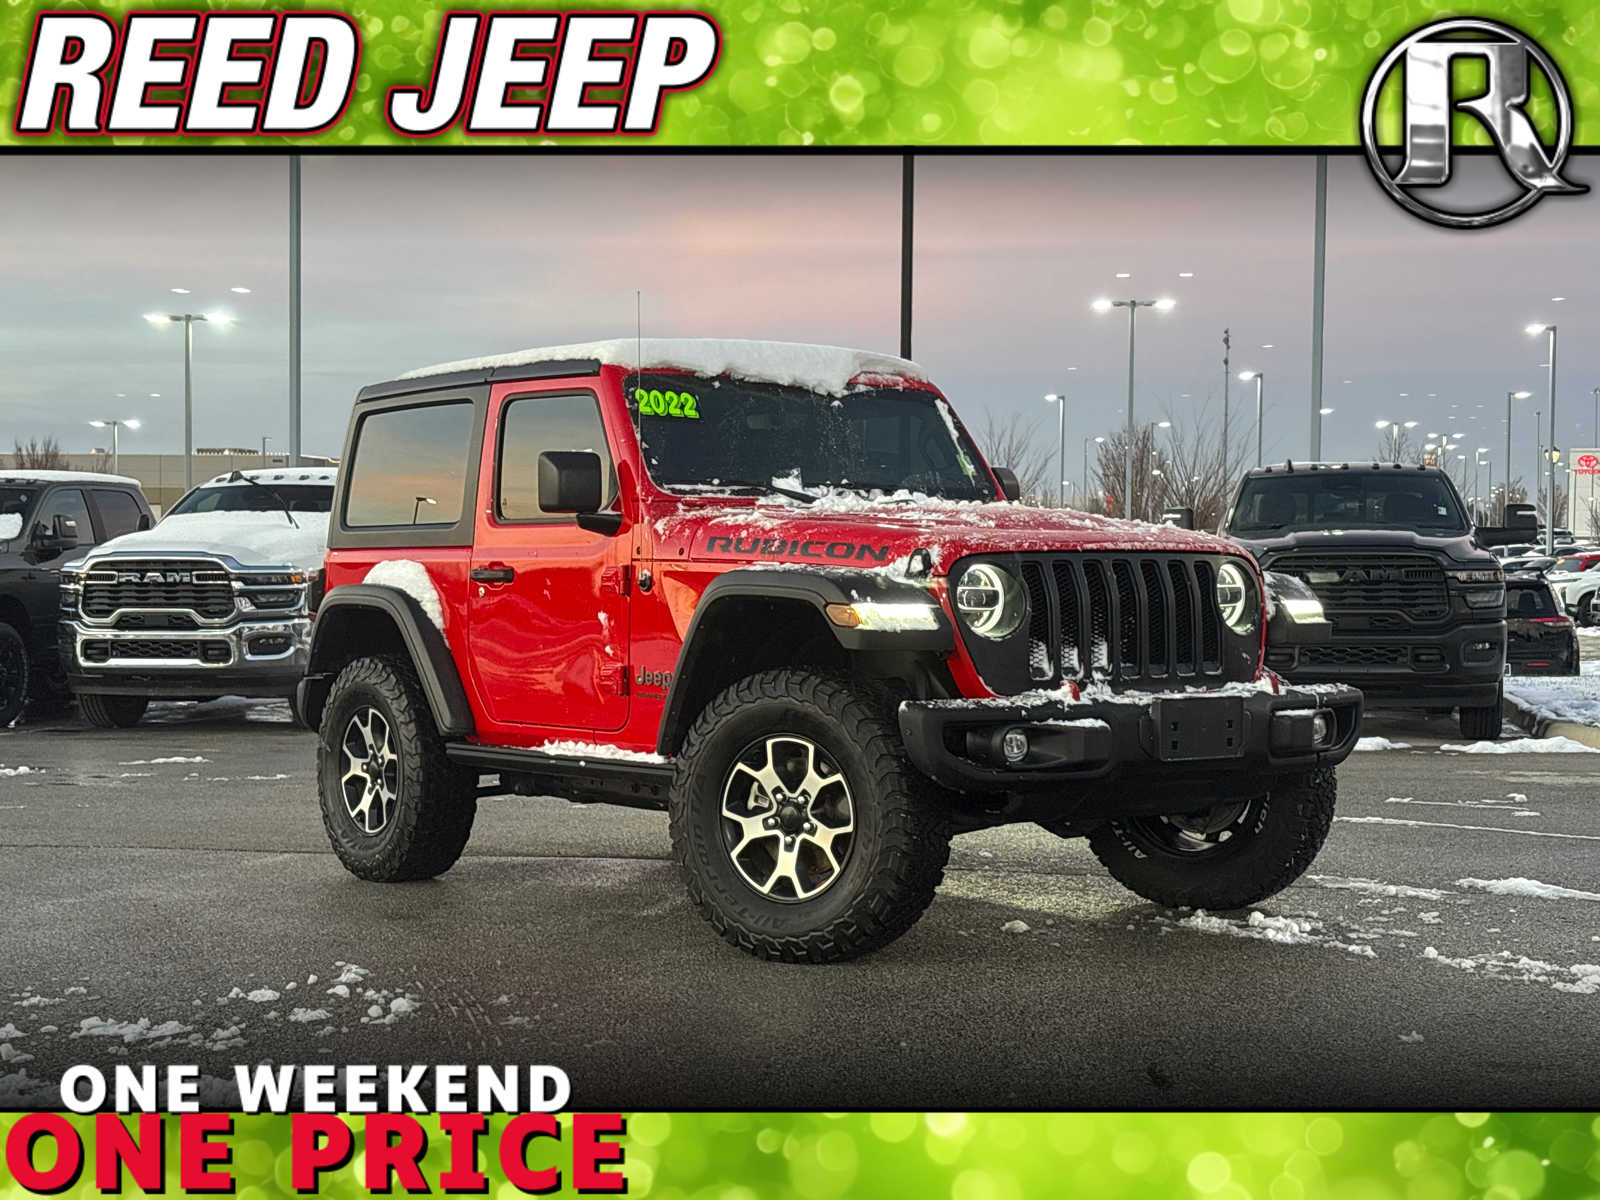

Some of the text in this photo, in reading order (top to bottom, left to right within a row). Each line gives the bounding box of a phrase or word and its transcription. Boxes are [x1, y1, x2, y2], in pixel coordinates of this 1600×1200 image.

[634, 388, 700, 419] 2022
[706, 535, 890, 563] RUBICON
[118, 571, 191, 583] RAM
[635, 664, 673, 690] Jeep
